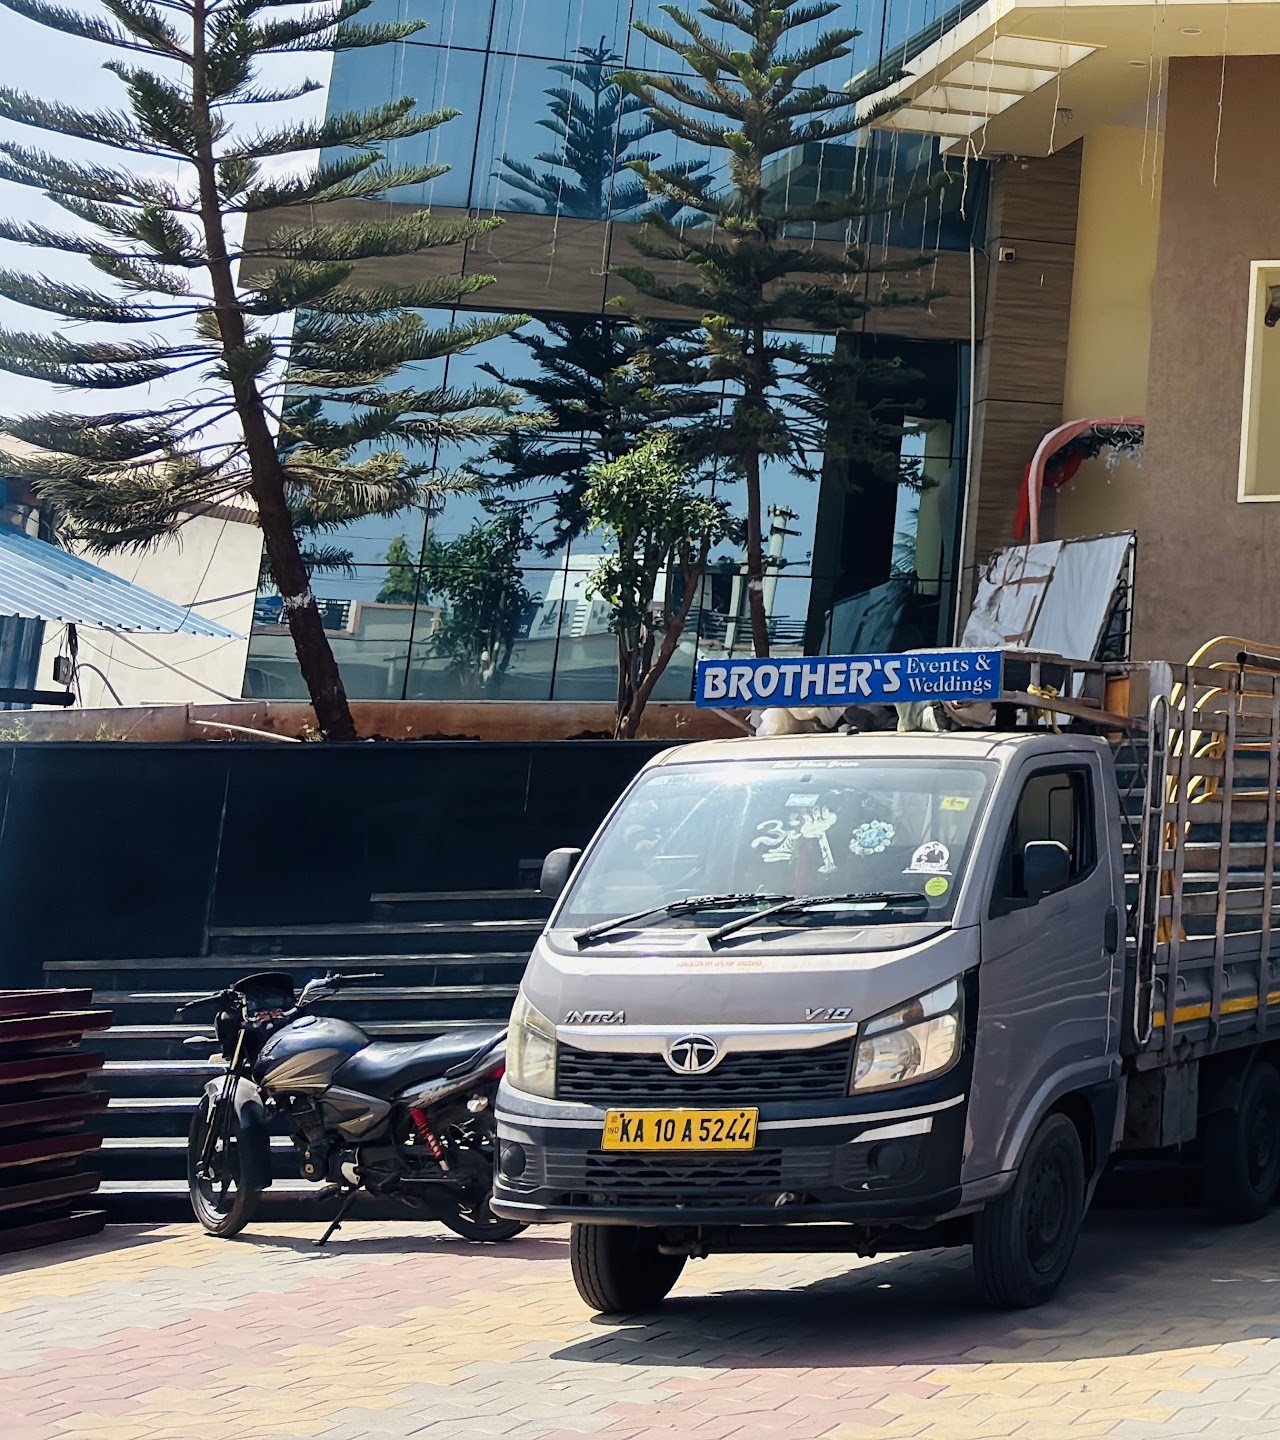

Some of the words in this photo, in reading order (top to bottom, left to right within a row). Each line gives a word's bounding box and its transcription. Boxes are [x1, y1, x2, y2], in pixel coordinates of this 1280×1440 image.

[906, 657, 968, 674] Events
[975, 653, 992, 672] &
[703, 659, 901, 701] BROTHER'S
[908, 675, 992, 696] Weddings
[565, 1010, 626, 1024] INTRA
[619, 1118, 644, 1143] KA
[654, 1118, 676, 1143] 10
[681, 1118, 692, 1143] A
[698, 1118, 752, 1143] 5244
